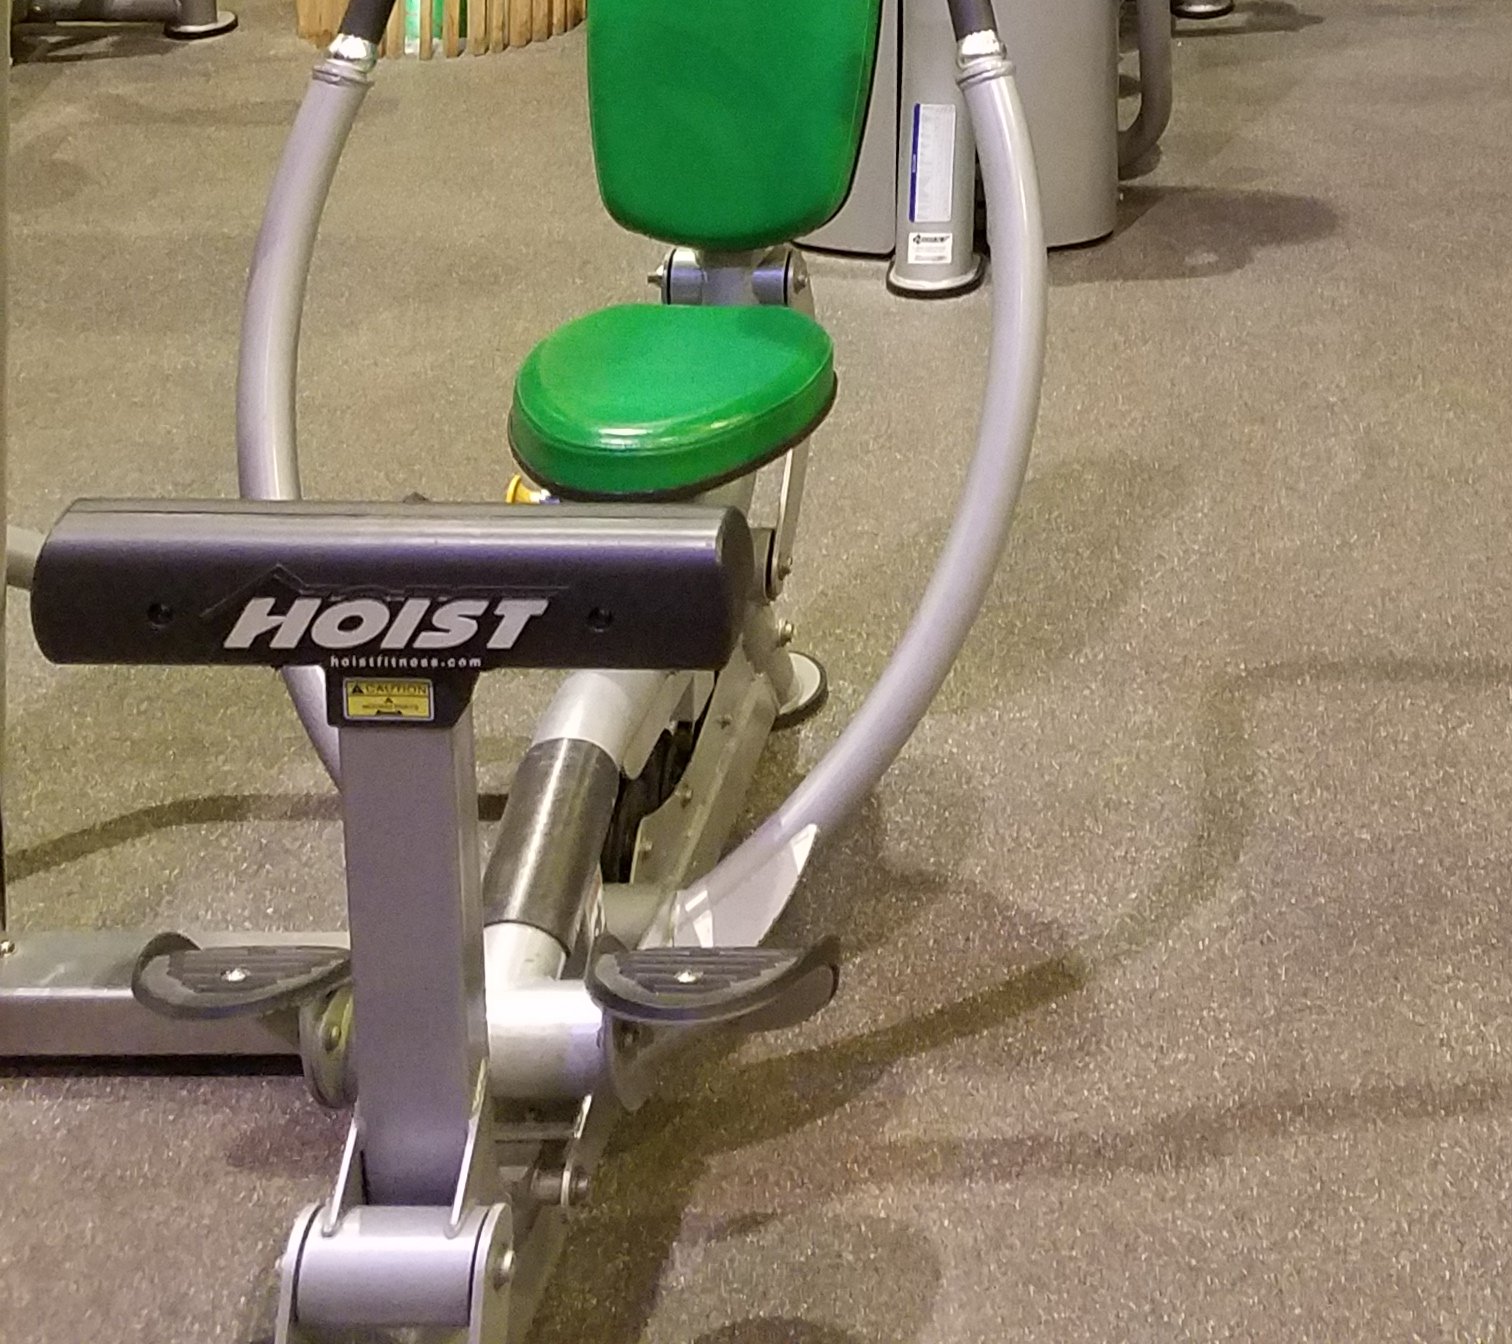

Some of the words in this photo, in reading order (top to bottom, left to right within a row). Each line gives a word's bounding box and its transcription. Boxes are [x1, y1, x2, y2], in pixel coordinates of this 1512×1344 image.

[223, 597, 550, 650] HOIST
[330, 655, 482, 669] hoistfitness.com
[365, 682, 427, 694] CAUTION
